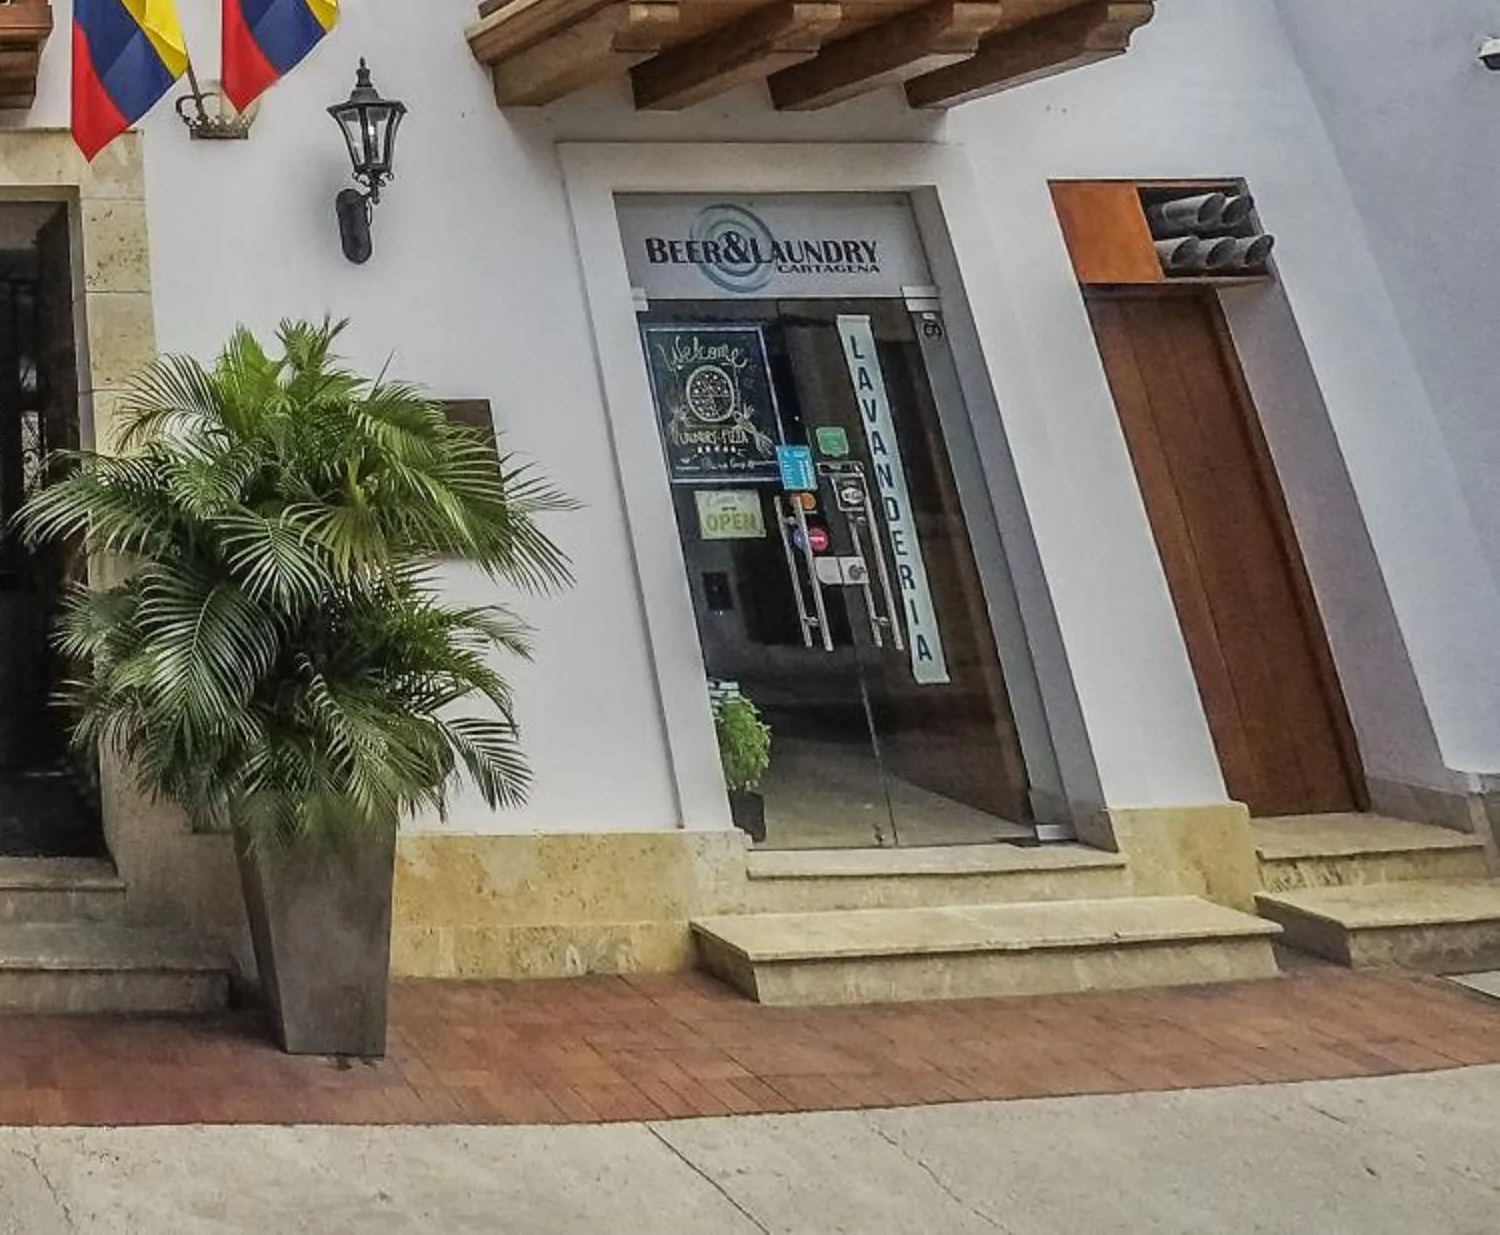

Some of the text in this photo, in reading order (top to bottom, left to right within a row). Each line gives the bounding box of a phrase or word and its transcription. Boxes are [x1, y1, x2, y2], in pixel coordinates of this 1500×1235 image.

[777, 264, 881, 274] CARTAGENA
[656, 335, 748, 372] Welcome
[850, 335, 934, 662] LAVANDERIA
[706, 512, 758, 532] OPEN
